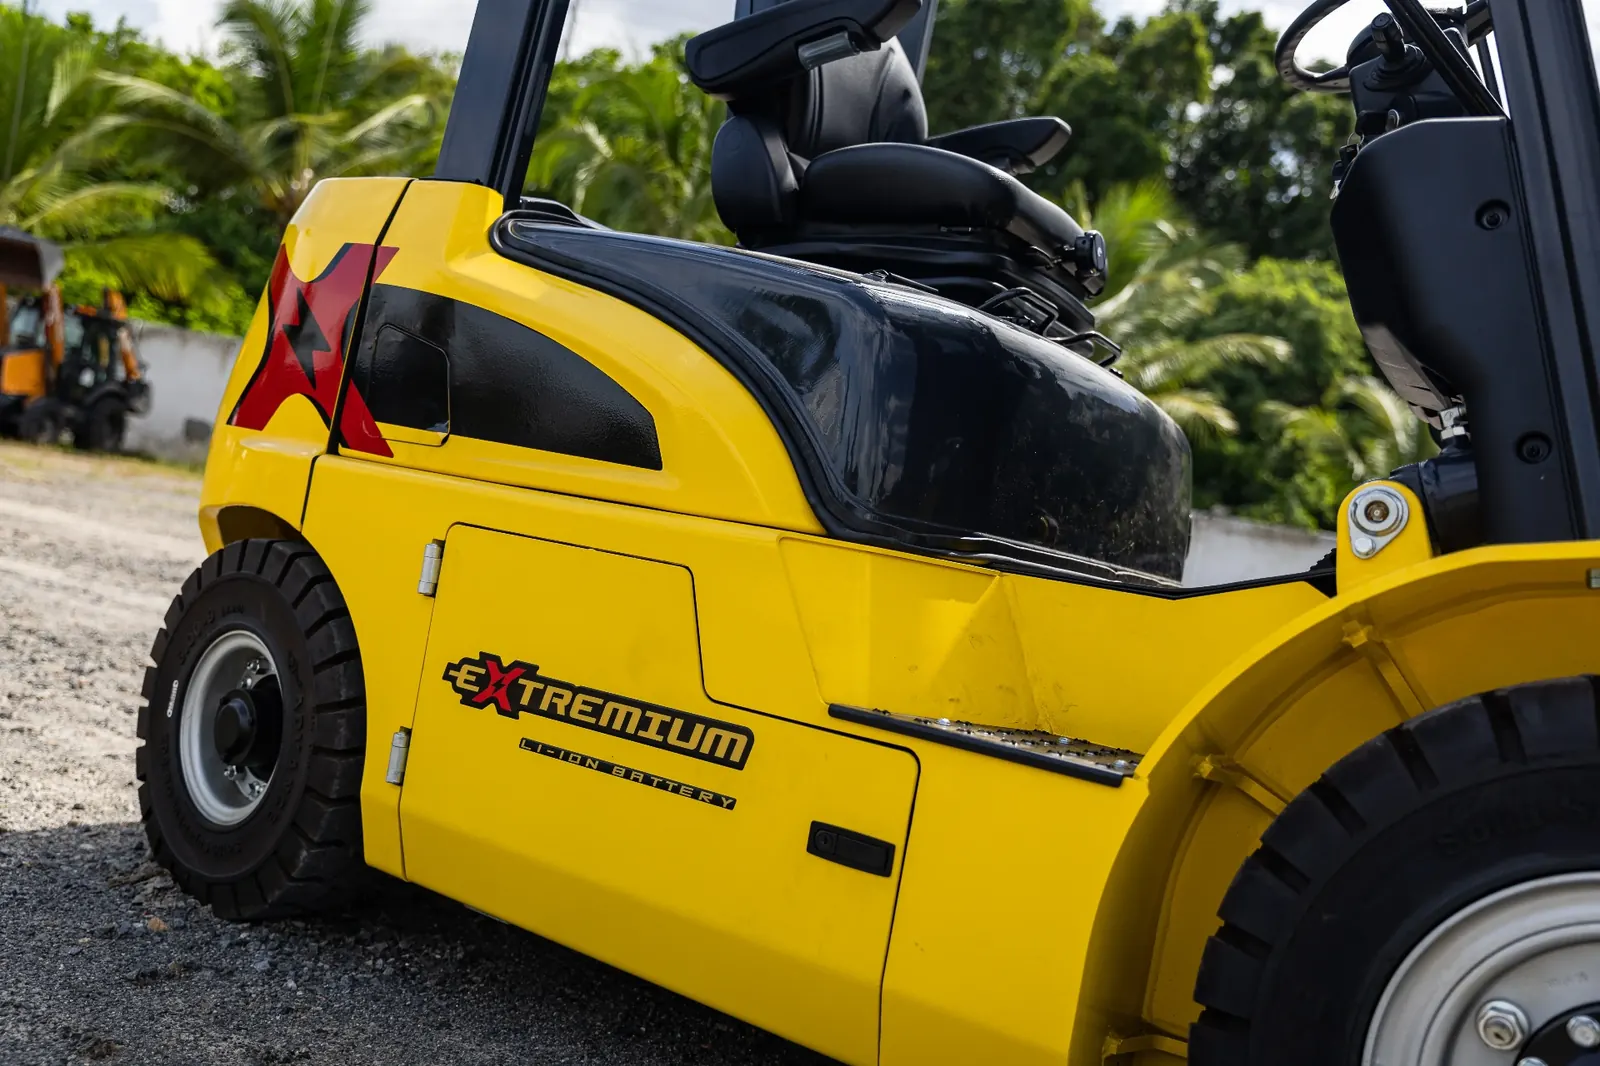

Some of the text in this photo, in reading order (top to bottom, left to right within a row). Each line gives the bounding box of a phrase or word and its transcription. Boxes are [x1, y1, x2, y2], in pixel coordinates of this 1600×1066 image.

[449, 660, 749, 763] EXTREMIUM
[520, 739, 734, 808] LI-ION BATTERY
